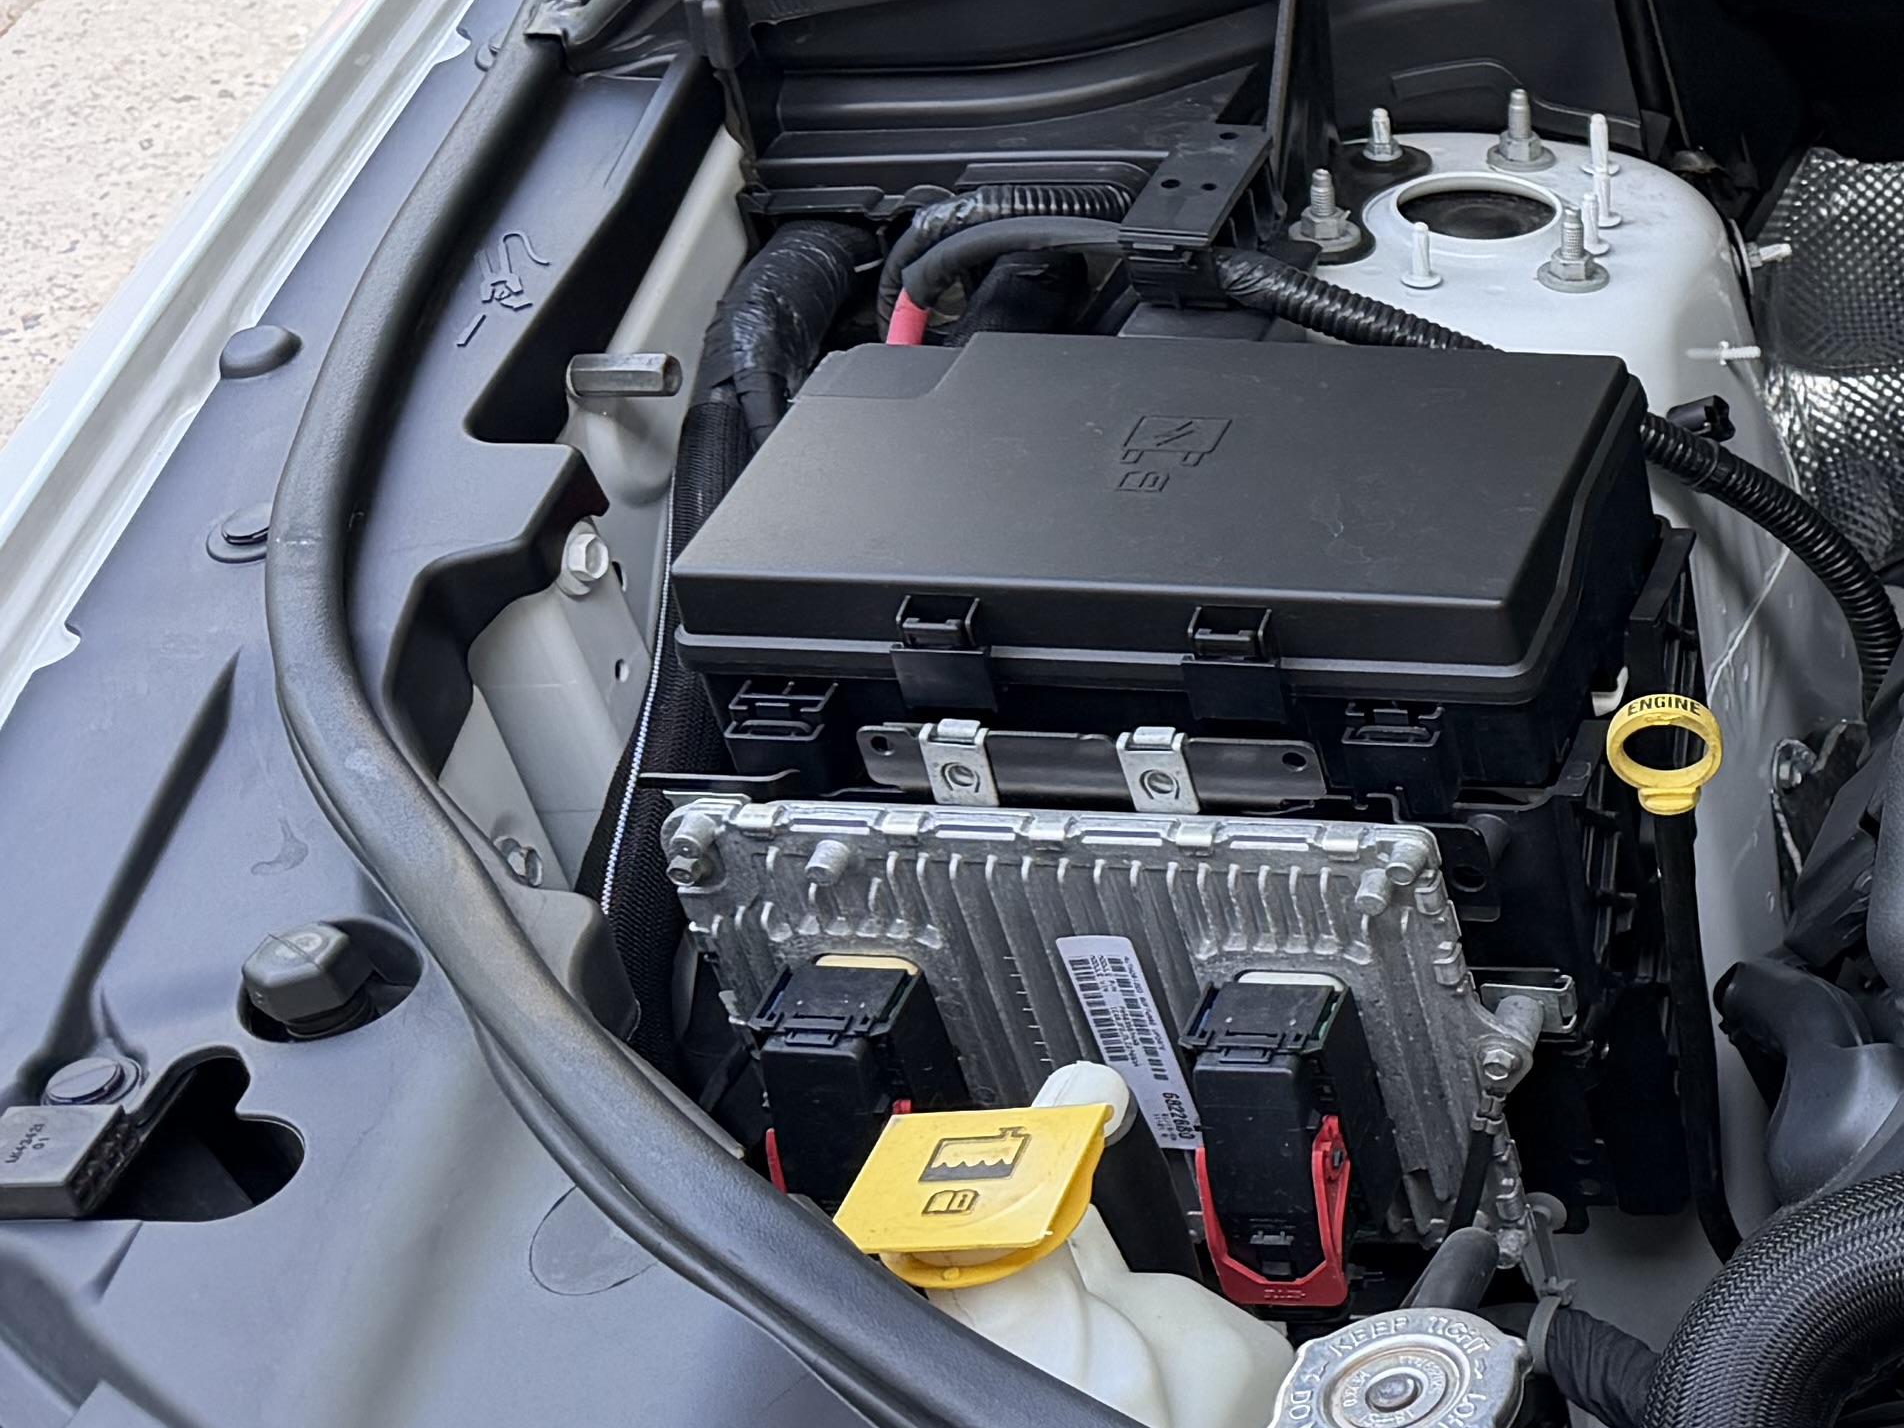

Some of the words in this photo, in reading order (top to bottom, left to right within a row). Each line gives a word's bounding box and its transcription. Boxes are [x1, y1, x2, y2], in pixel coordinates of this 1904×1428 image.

[1627, 695, 1702, 717] ENGINE
[1328, 1316, 1410, 1358] KEEP
[1289, 1390, 1312, 1421] DO
